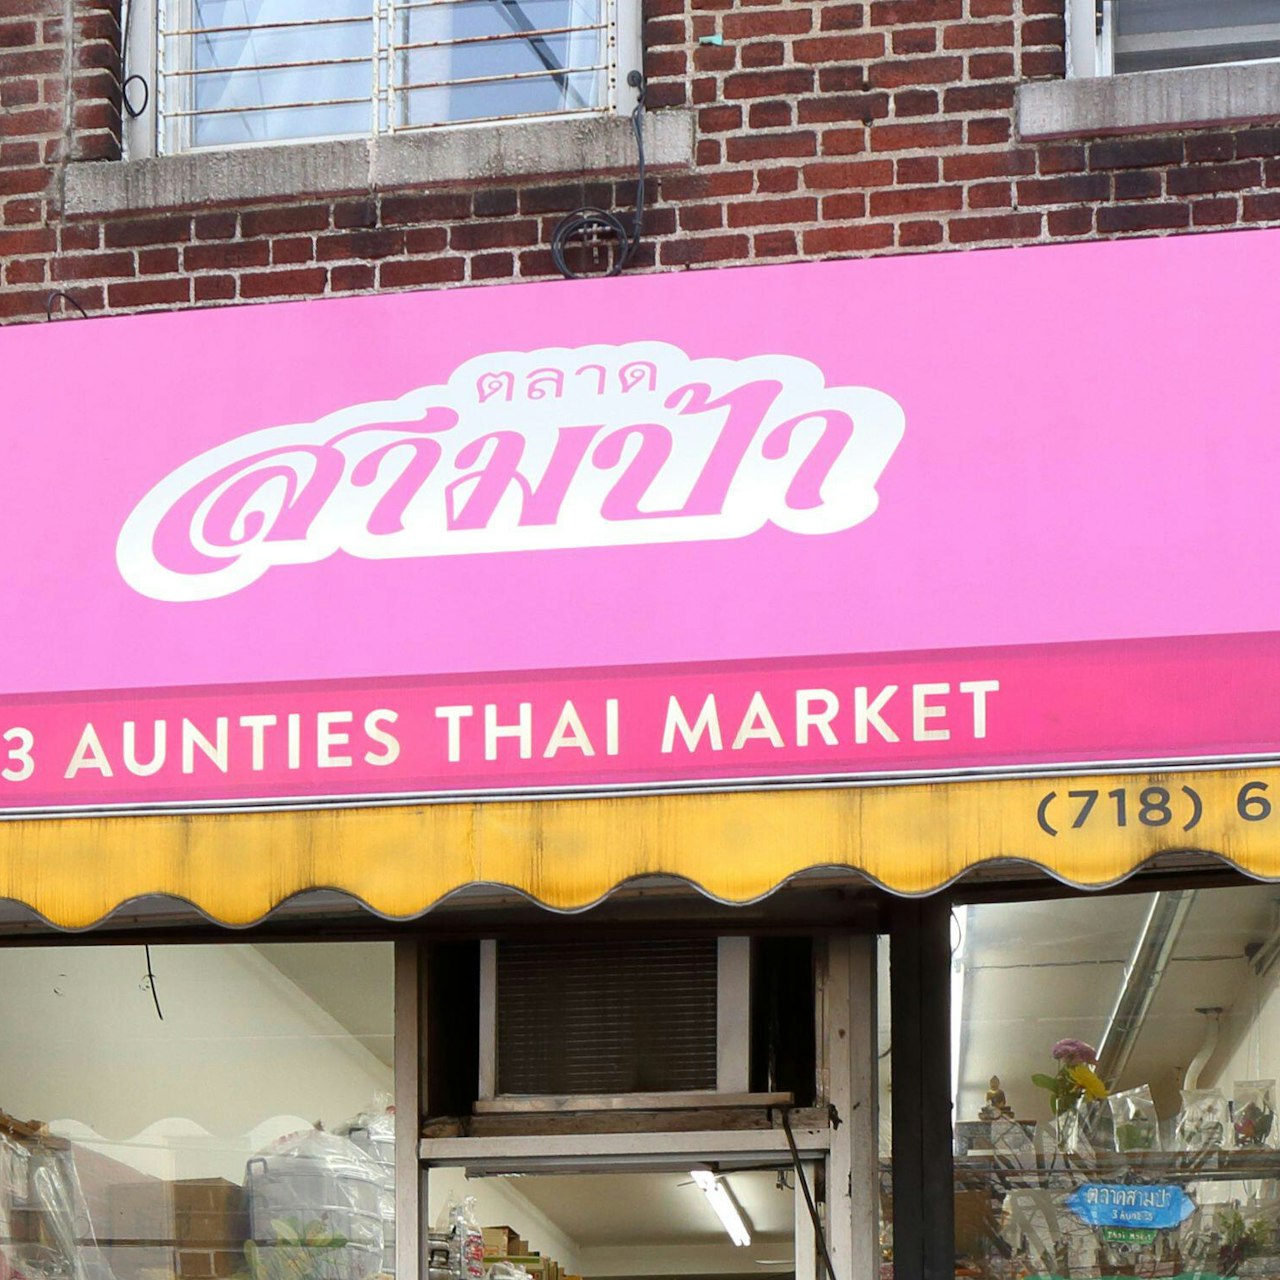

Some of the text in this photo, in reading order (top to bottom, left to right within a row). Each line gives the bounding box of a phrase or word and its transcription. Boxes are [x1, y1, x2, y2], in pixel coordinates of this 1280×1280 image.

[477, 360, 657, 403] ตลาด
[1, 680, 1000, 782] 3 AUNTIES THAI MARKET
[1037, 785, 1204, 837] (718)
